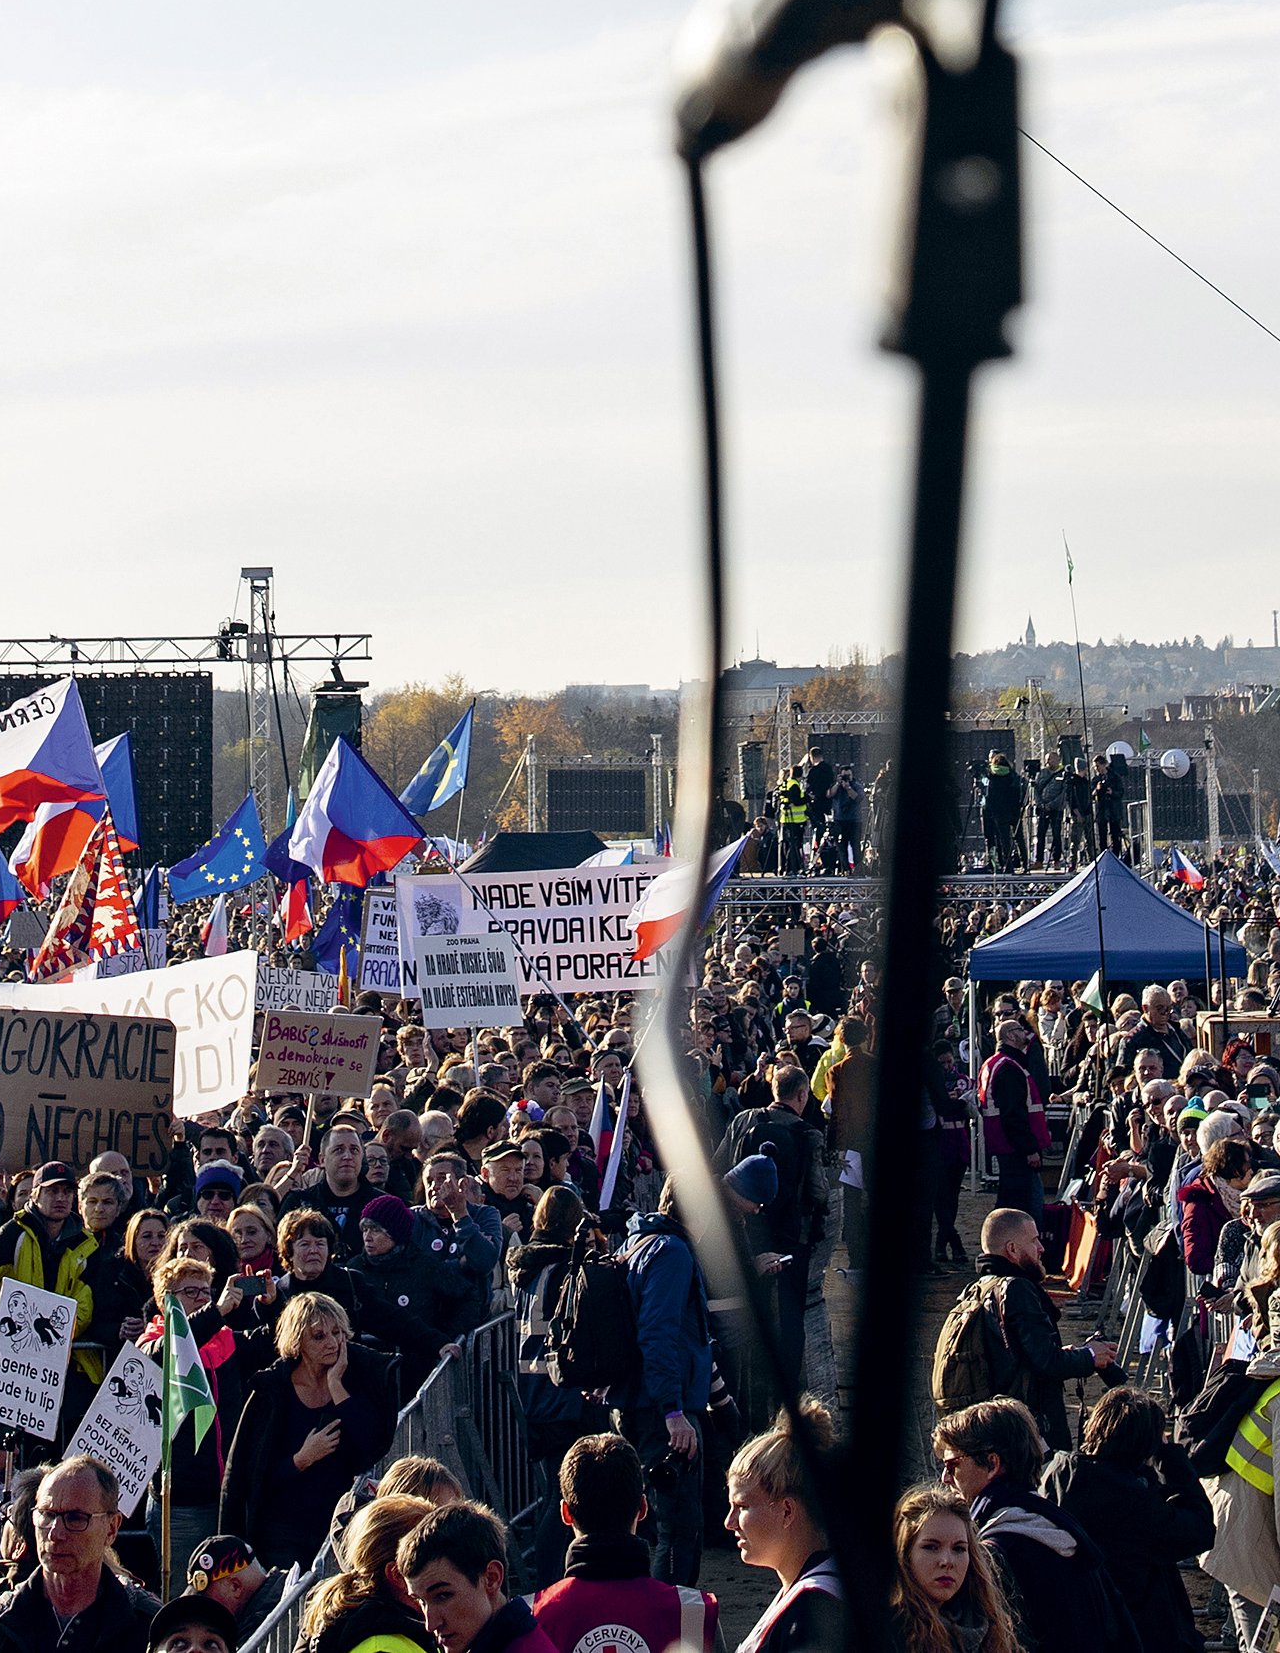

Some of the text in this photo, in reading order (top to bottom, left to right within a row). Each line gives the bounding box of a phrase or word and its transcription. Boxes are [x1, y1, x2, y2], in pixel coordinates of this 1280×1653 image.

[472, 871, 657, 911] NADE VŠÍM VÍTĚ
[446, 937, 480, 947] ZOO PRAHA
[589, 916, 595, 943] I
[424, 954, 435, 976] NA
[437, 950, 460, 976] HRADĚ
[461, 952, 486, 975] RUSKEJ
[488, 947, 507, 974] ŠVÁB
[422, 987, 433, 1009] NA
[435, 982, 455, 1009] VLÁDĚ
[496, 985, 518, 1008] KRYSA
[265, 1047, 363, 1072] a demokracie se
[41, 1366, 60, 1388] StB
[24, 1387, 38, 1405] tu
[39, 1390, 56, 1413] líp
[16, 1409, 46, 1433] tebe
[95, 1413, 149, 1466] BEZ ŘEPKY A
[84, 1424, 146, 1482] PODVODNÍKŮ
[585, 1627, 645, 1651] ČERVENÝ
